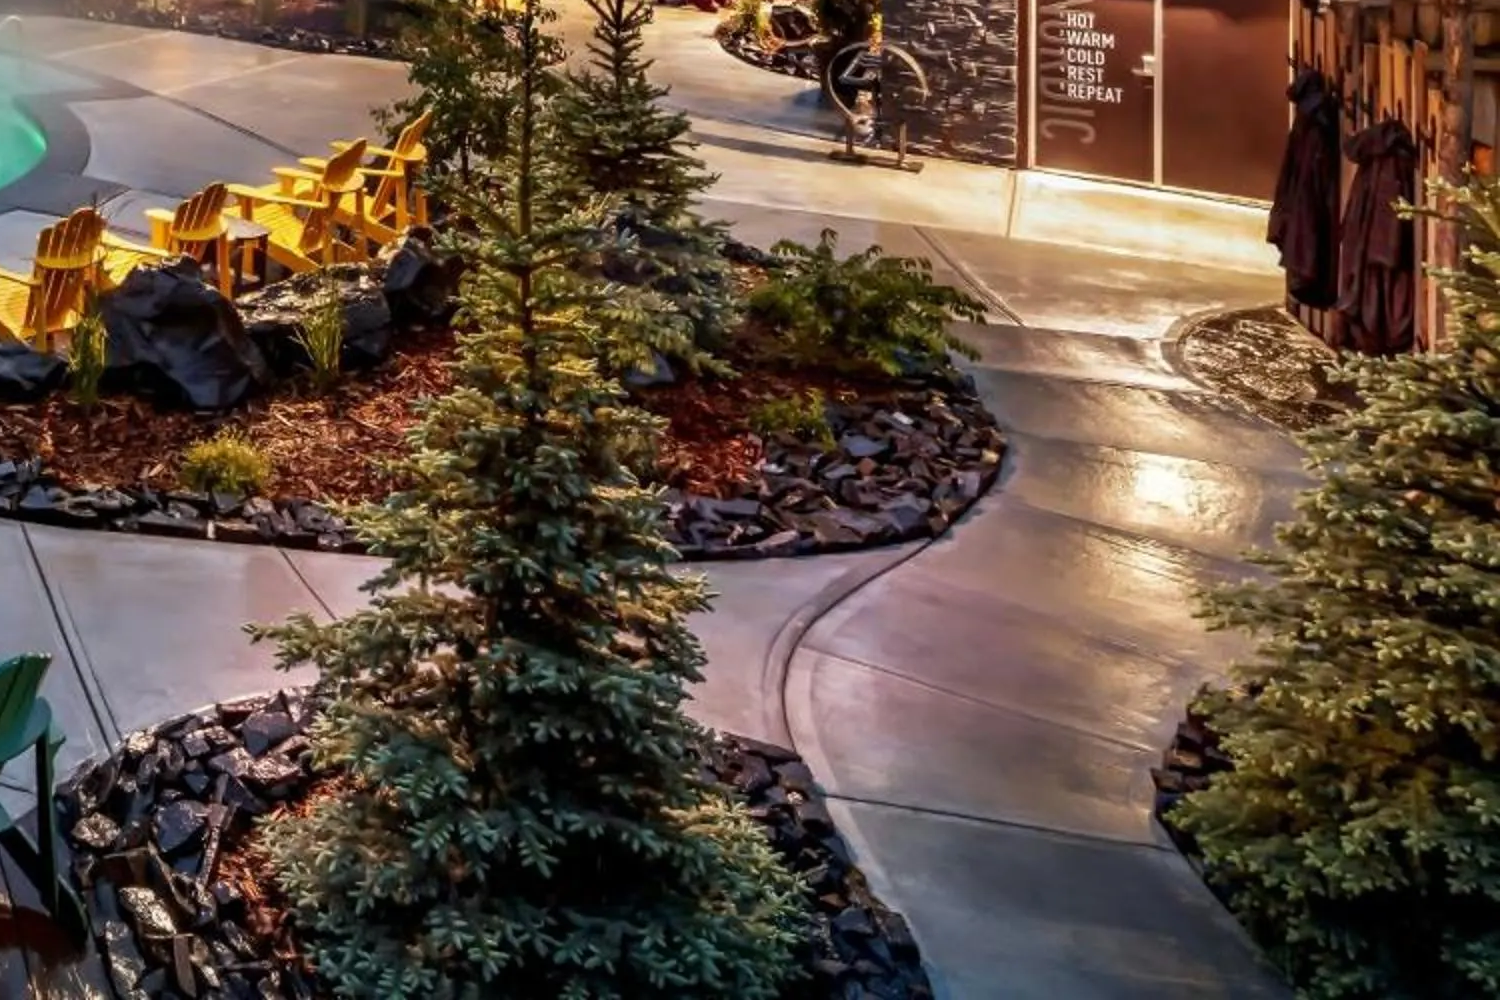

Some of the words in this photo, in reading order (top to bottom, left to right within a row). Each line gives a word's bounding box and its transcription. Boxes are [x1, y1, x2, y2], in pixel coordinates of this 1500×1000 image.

[1067, 12, 1095, 29] HOT
[1066, 29, 1115, 49] WARM
[1067, 47, 1105, 66] COLD
[1067, 65, 1105, 83] REST
[1067, 83, 1124, 104] REPEAT
